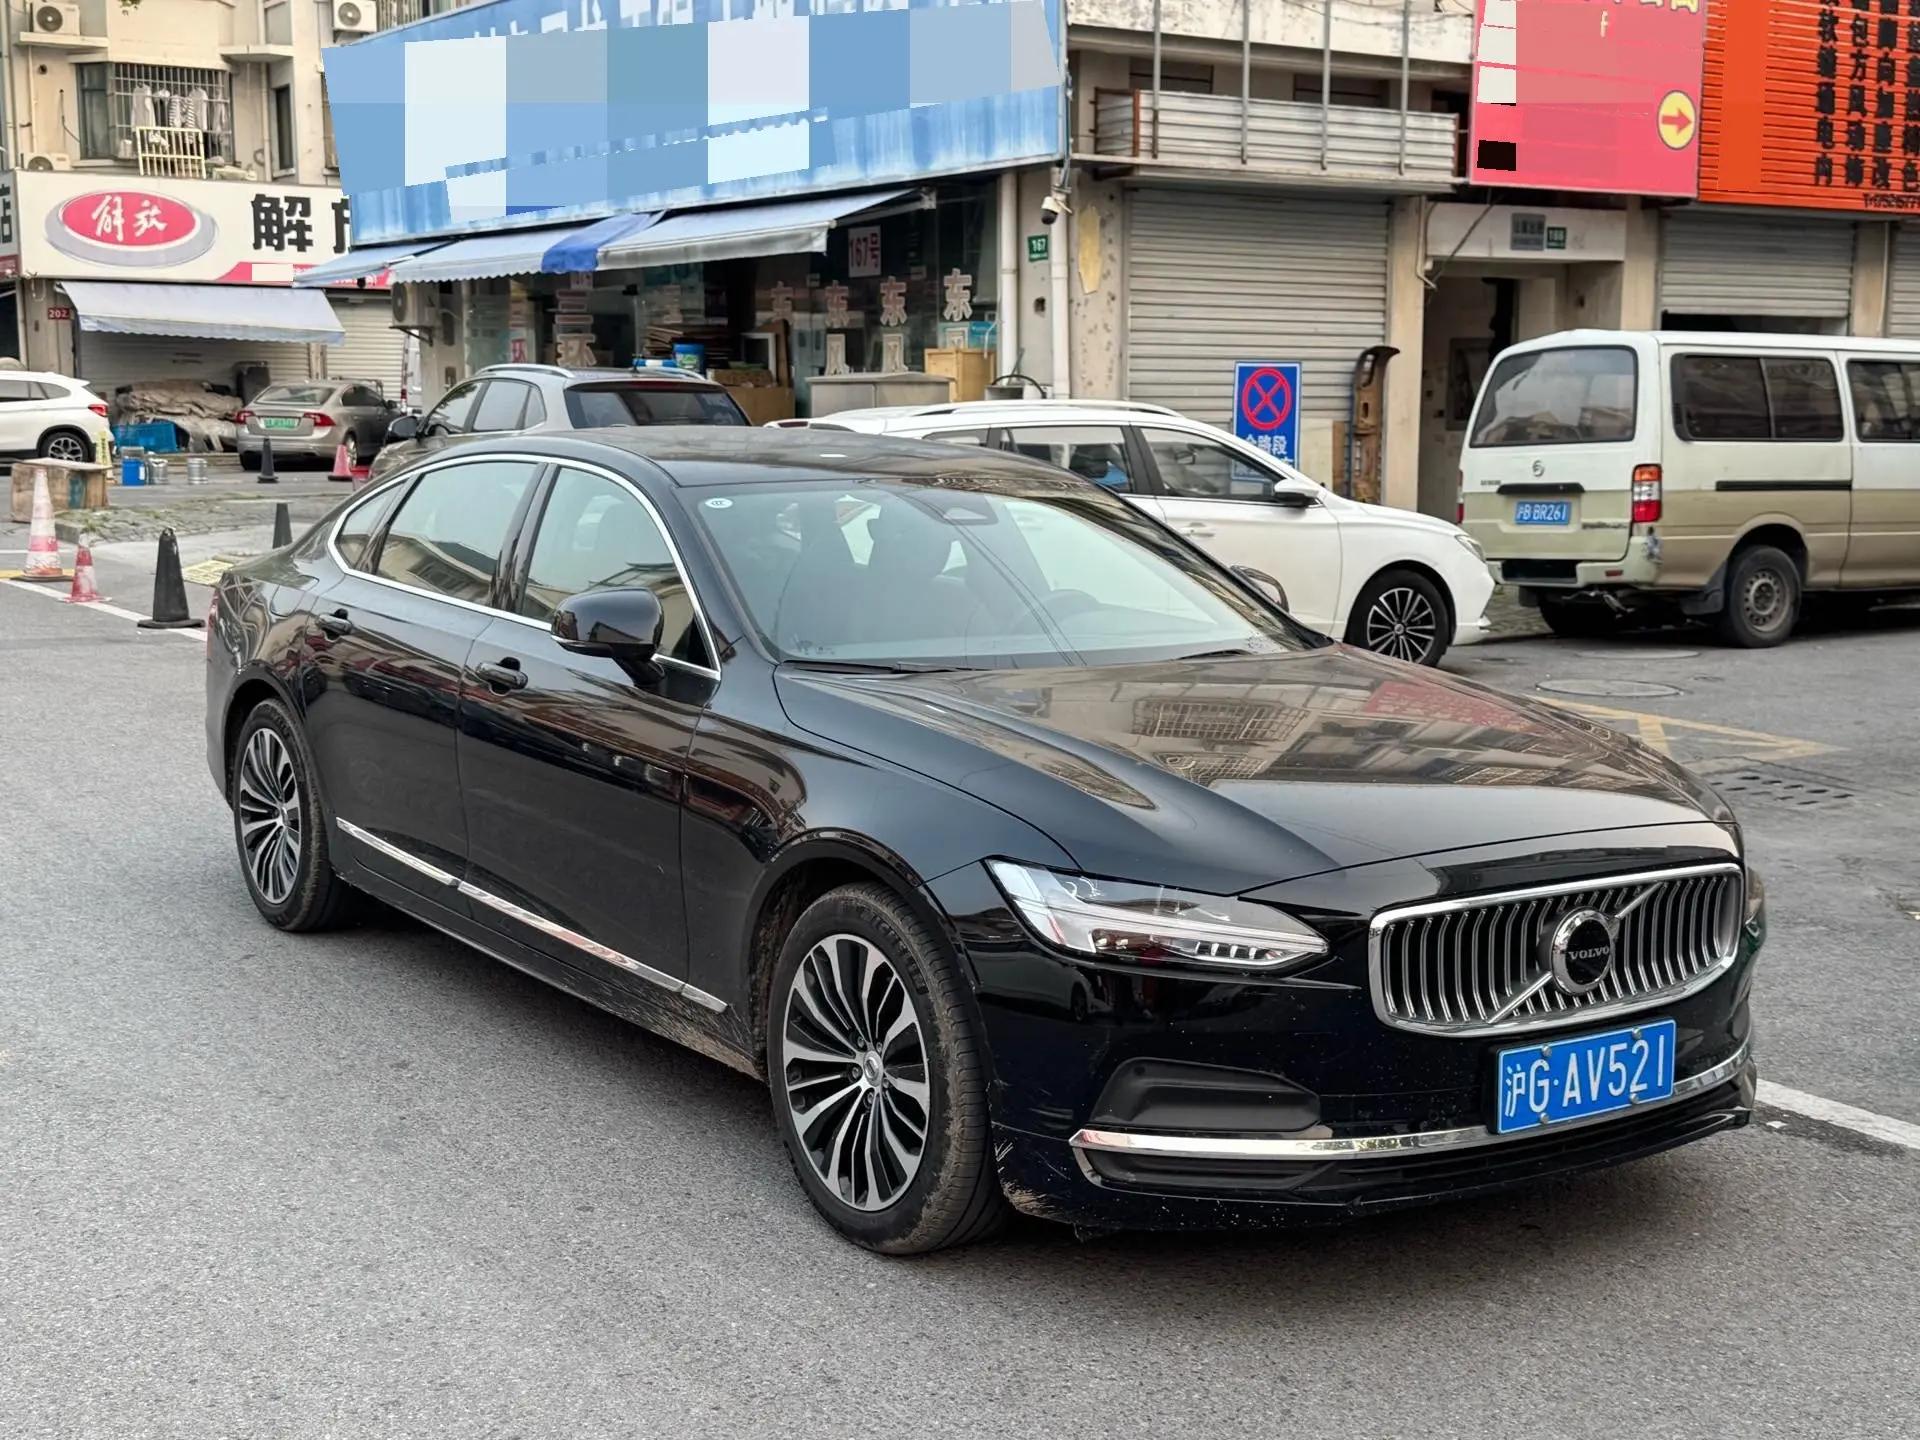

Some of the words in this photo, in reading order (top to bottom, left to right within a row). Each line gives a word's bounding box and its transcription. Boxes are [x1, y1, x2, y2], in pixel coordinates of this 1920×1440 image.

[91, 195, 168, 242] 解放
[849, 232, 880, 268] 167号
[1032, 239, 1046, 251] 167
[50, 309, 67, 318] 202
[1568, 945, 1610, 960] VOLVO
[1505, 1035, 1664, 1117] 沪G·AV521
